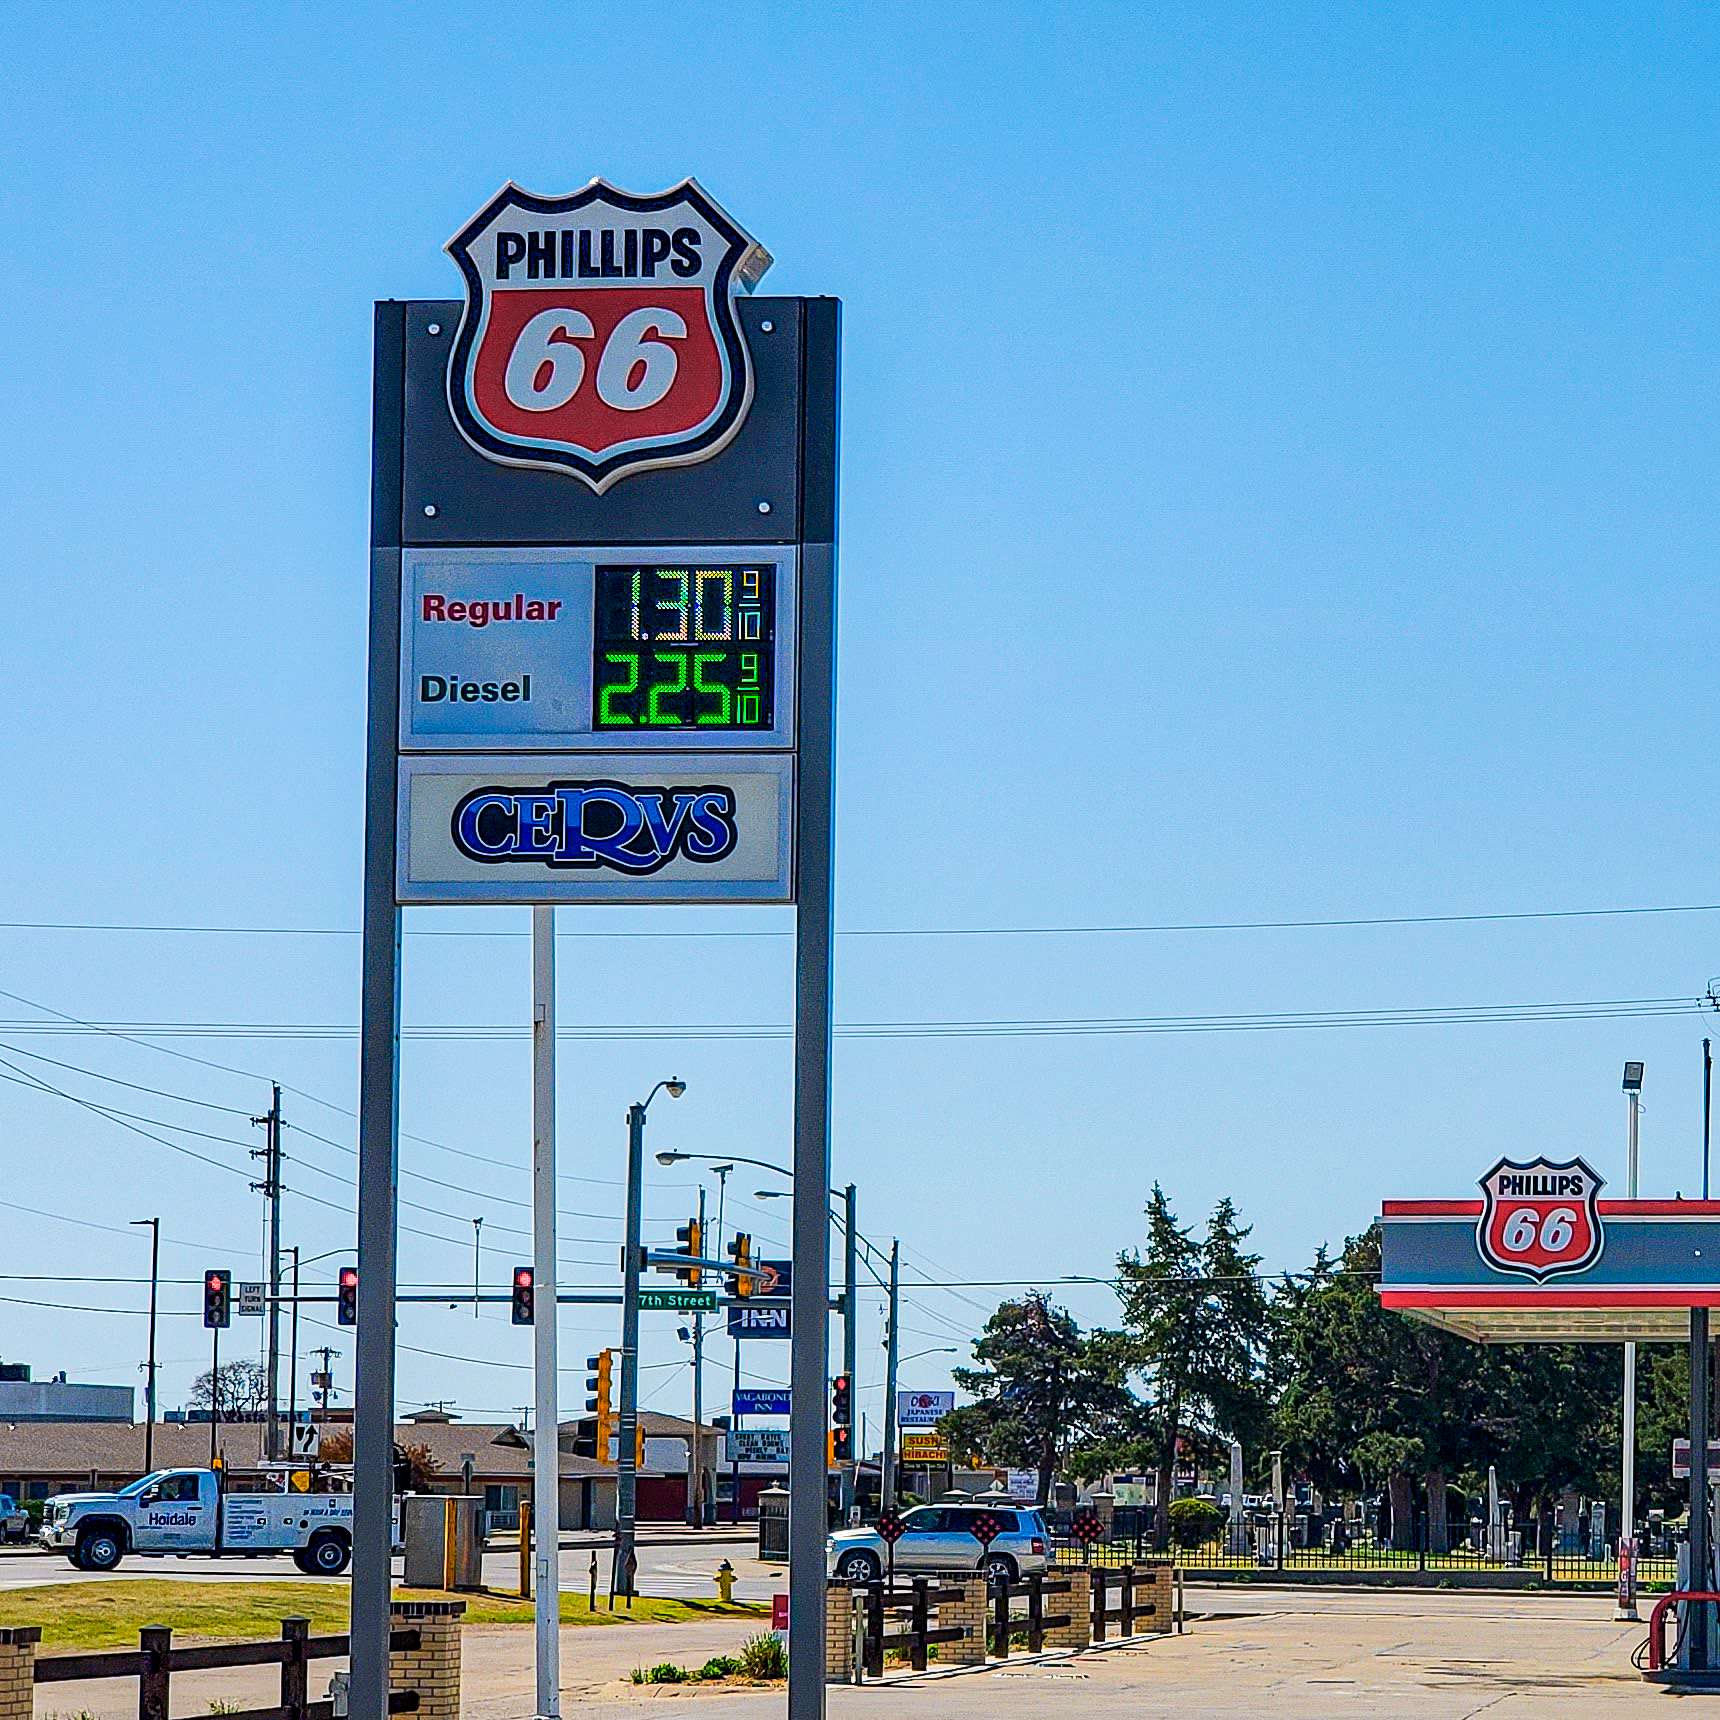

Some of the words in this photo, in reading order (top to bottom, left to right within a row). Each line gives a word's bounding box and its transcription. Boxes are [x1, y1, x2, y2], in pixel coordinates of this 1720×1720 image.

[496, 227, 702, 280] PHILLIPS
[504, 306, 688, 412] 66
[422, 593, 562, 628] Regular
[630, 569, 732, 641] 1.30
[420, 674, 531, 703] Diesel
[600, 653, 731, 724] 2.25
[457, 786, 732, 869] CERVS
[1498, 1175, 1584, 1196] PHILLIPS
[1503, 1208, 1577, 1252] 66
[639, 1295, 662, 1307] 7th
[667, 1295, 711, 1307] Street
[741, 1309, 787, 1328] INN
[754, 1403, 773, 1411] INN
[148, 1512, 197, 1526] Hoidale
